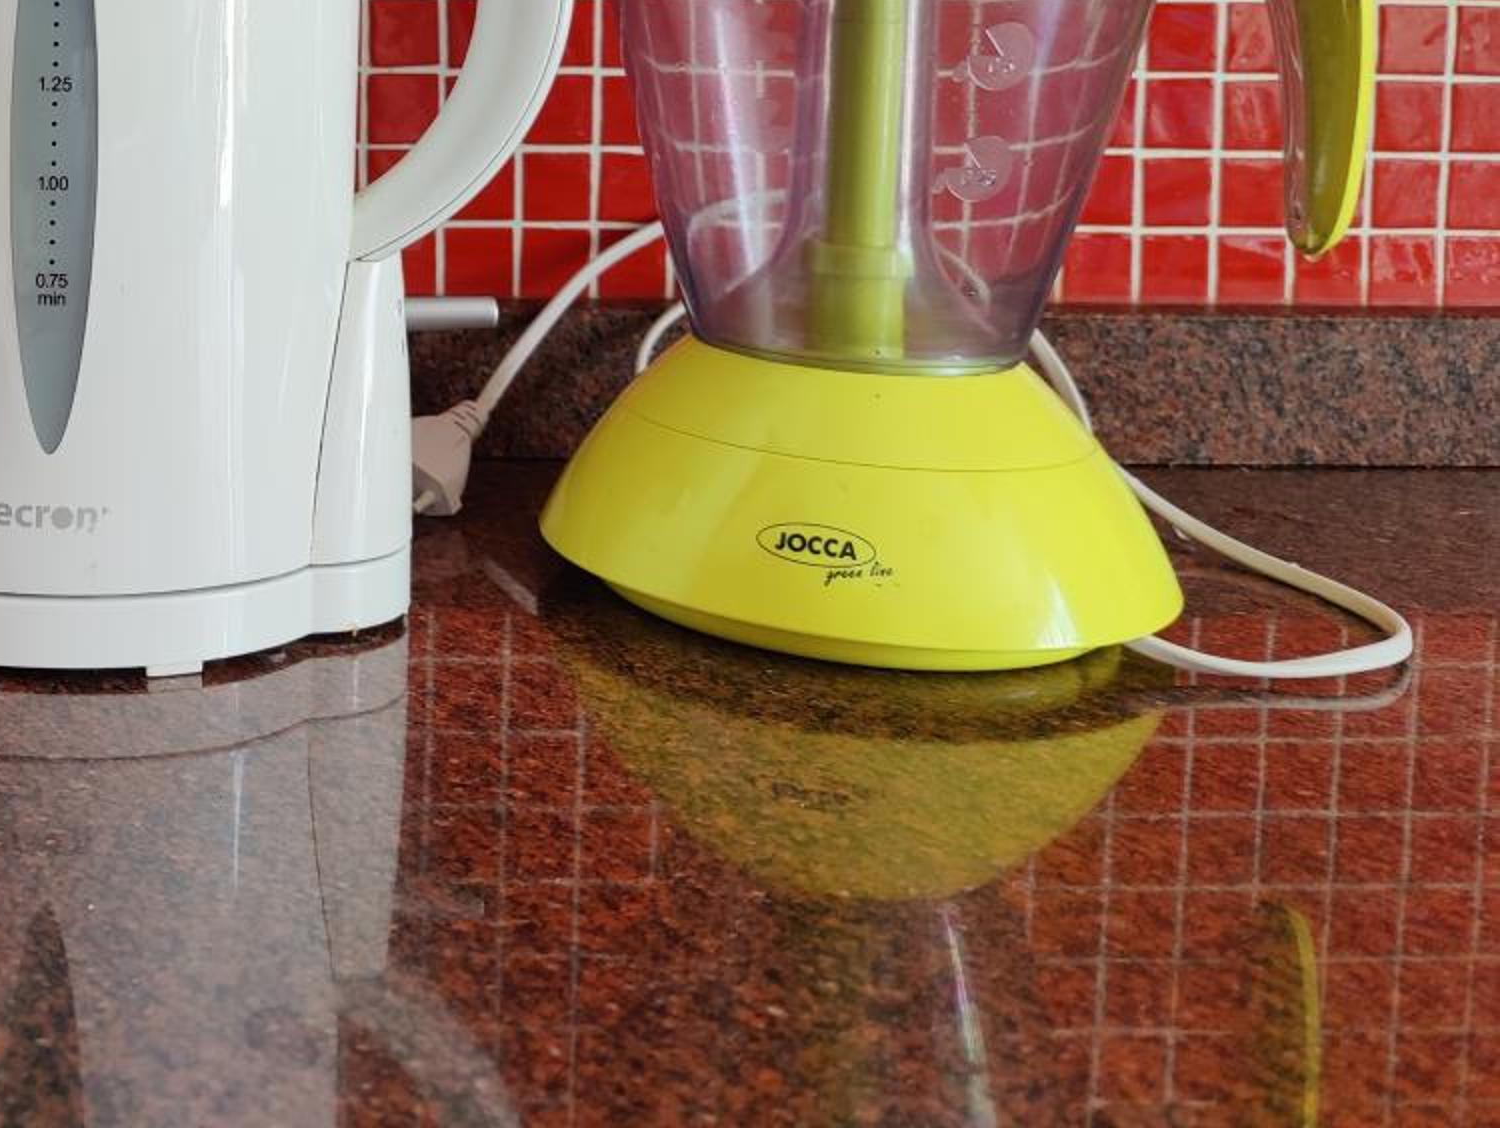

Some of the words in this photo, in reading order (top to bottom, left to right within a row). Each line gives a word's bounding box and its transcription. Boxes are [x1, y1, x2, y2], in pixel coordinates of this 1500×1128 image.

[38, 77, 73, 92] 1.25
[38, 176, 69, 191] 1.00
[35, 273, 69, 289] 0.75
[37, 292, 67, 306] min
[774, 531, 857, 560] JOCCA
